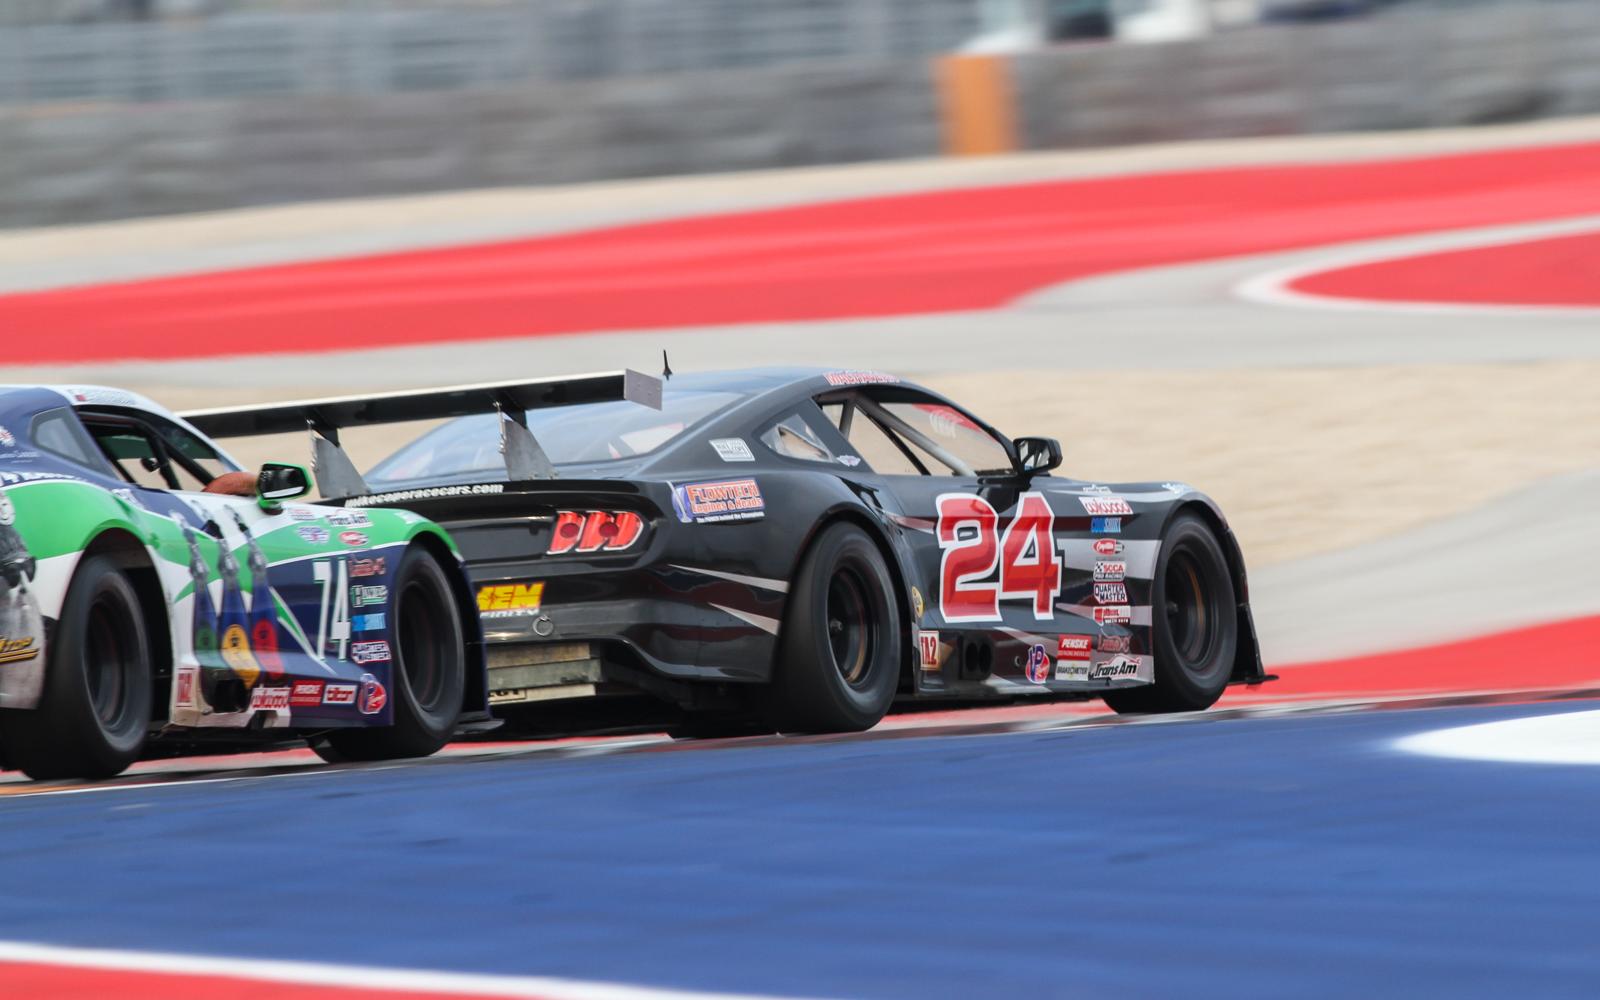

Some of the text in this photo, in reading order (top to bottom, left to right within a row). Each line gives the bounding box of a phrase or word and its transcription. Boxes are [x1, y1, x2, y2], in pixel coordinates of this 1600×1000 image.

[688, 483, 759, 503] FLOWTECH
[691, 498, 764, 514] Engines & Heads
[936, 492, 1062, 623] 24
[1104, 564, 1124, 573] SCCA
[1094, 584, 1124, 596] QUARTER
[1100, 593, 1126, 602] MASTER
[312, 557, 351, 662] 74
[920, 634, 937, 666] TA2
[1061, 638, 1089, 649] PENSKE
[1095, 661, 1137, 677] Trans Am
